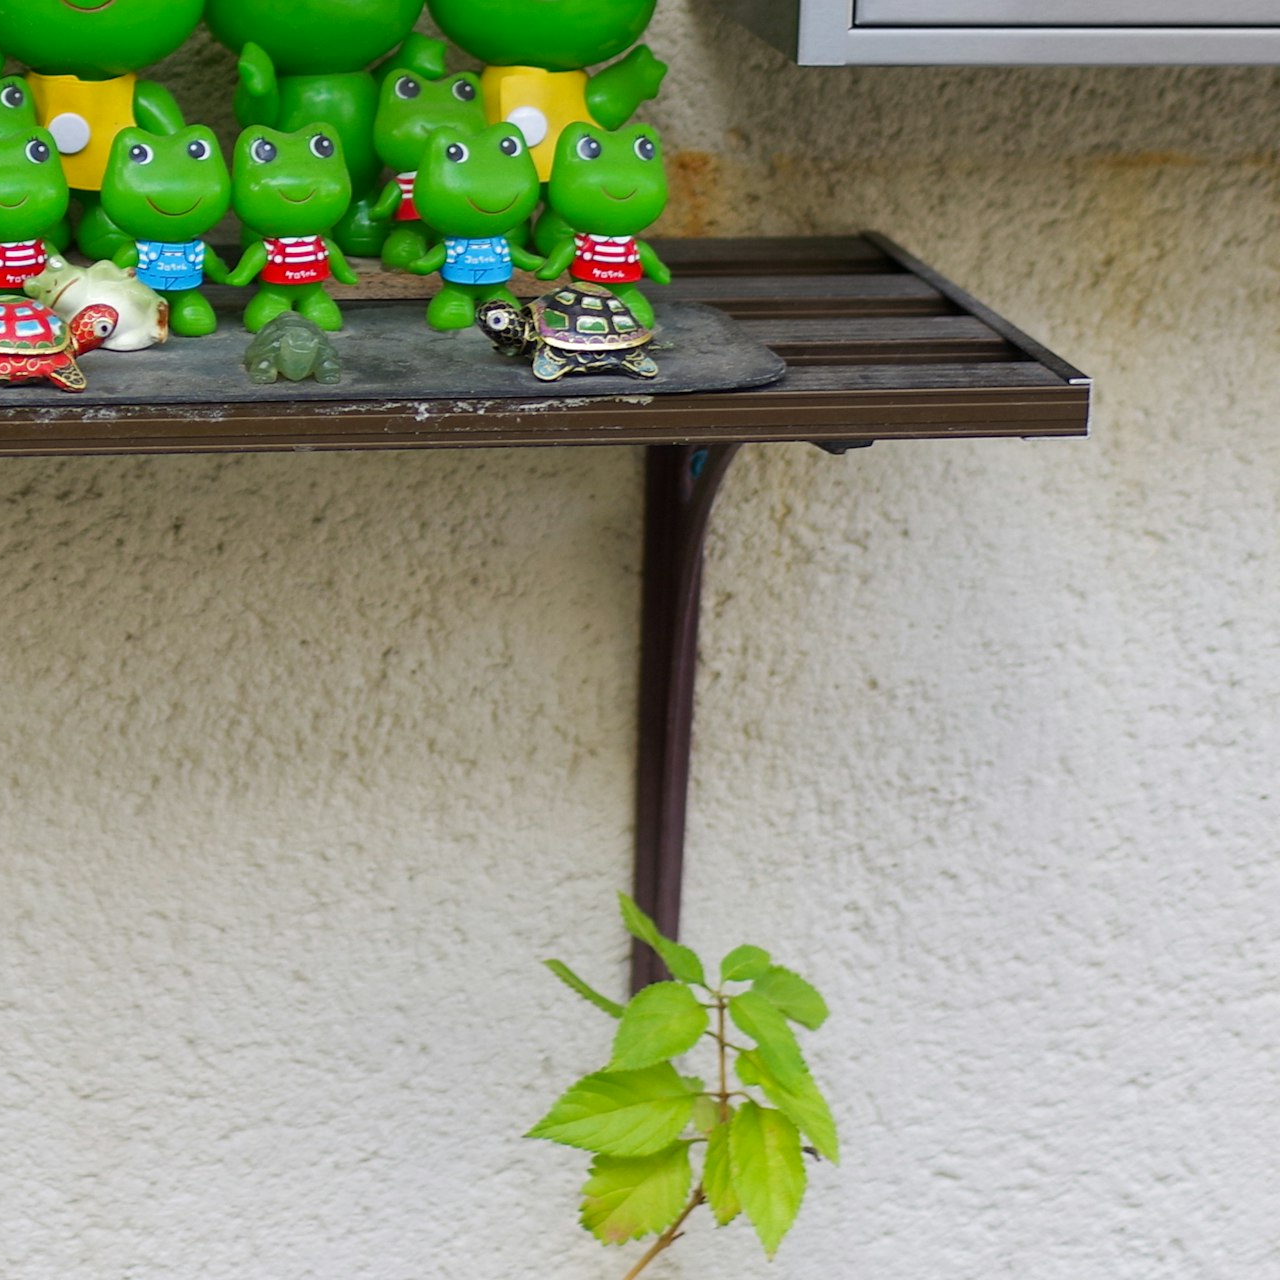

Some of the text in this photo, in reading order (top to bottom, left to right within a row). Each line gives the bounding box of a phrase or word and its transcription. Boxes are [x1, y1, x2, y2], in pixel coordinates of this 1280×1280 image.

[285, 269, 318, 280] ケロちゃん
[592, 268, 625, 279] ケロちゃん
